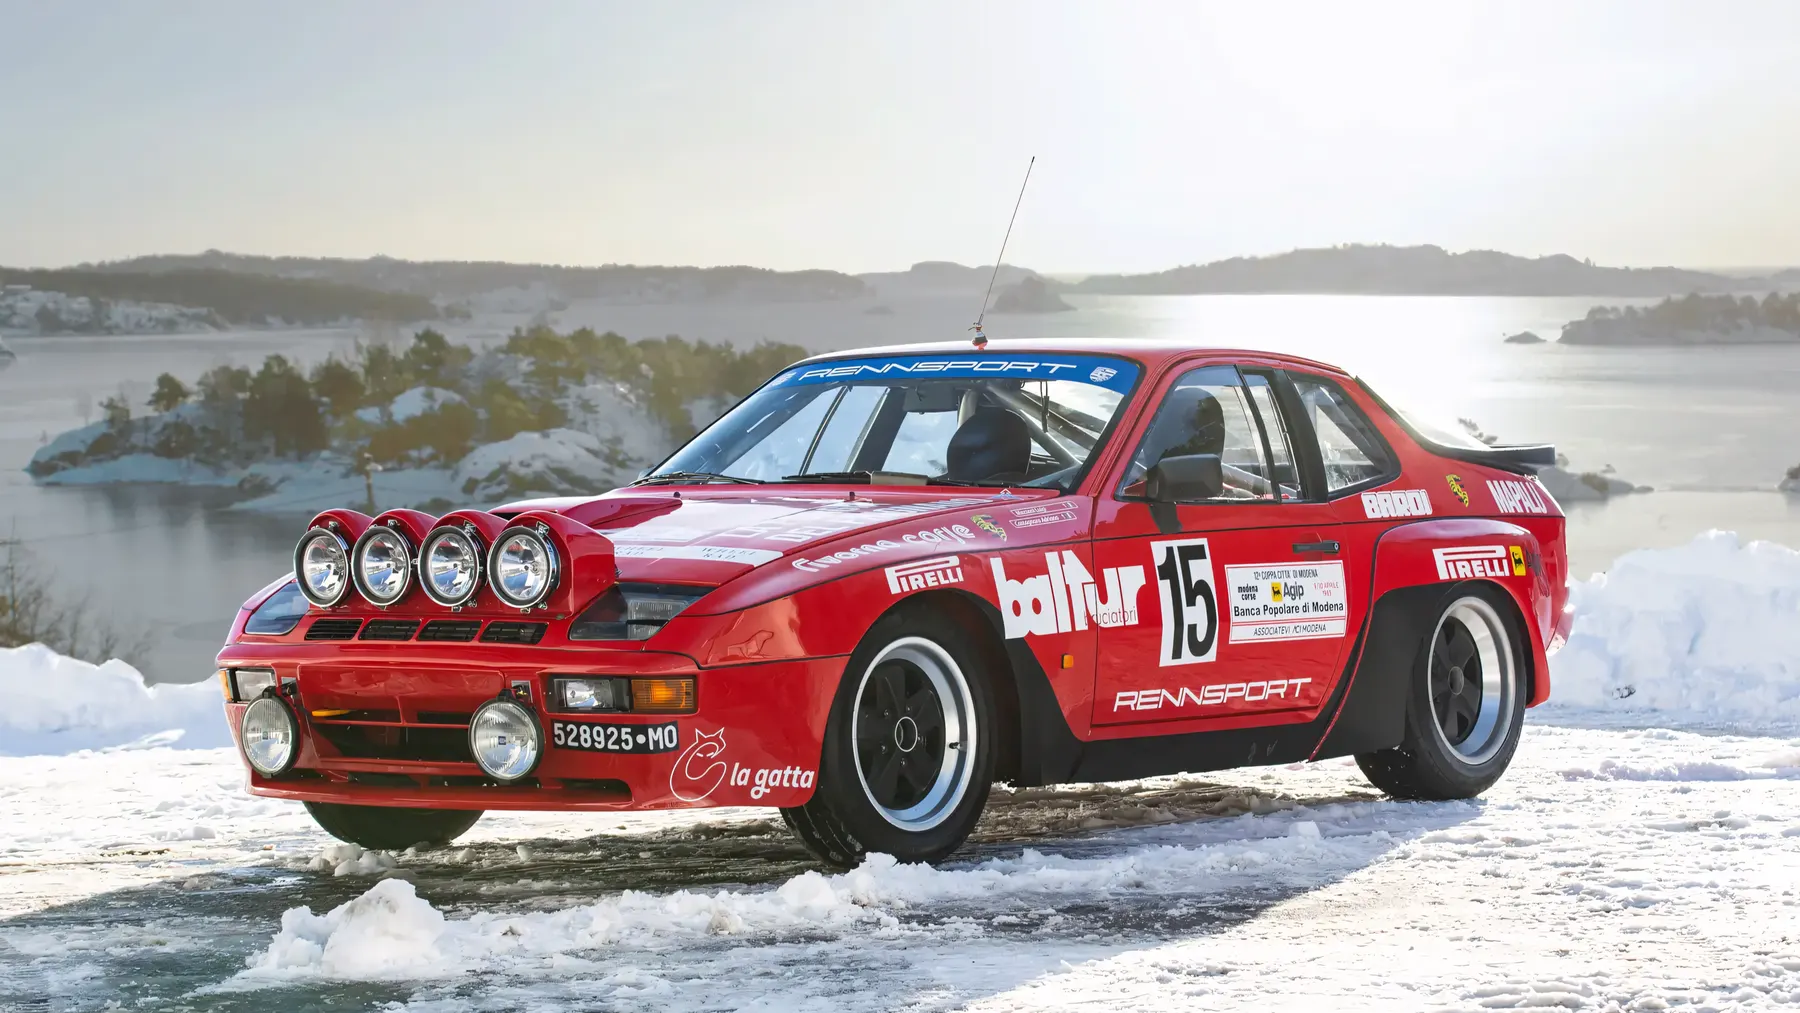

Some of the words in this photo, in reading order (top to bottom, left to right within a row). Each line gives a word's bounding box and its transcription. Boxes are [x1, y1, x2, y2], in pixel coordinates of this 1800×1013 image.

[799, 361, 1077, 381] RENNSPORT
[1361, 489, 1433, 519] BARDI
[884, 555, 964, 595] PIRELLI
[1261, 570, 1277, 580] COPPA
[1298, 568, 1319, 578] MODENA
[1432, 545, 1510, 580] PIRELLI
[990, 549, 1146, 640] baltur
[1237, 584, 1259, 593] modena
[1241, 592, 1257, 601] corse
[1283, 581, 1304, 601] Agip
[1157, 544, 1217, 660] 15
[1234, 605, 1261, 617] Banca
[1263, 602, 1300, 617] Popolare
[1302, 602, 1310, 613] di
[1312, 601, 1344, 612] Modena
[1302, 624, 1326, 633] MODENA
[1113, 677, 1312, 712] RENNSPORT
[730, 762, 749, 786] la
[750, 766, 815, 799] gatta
